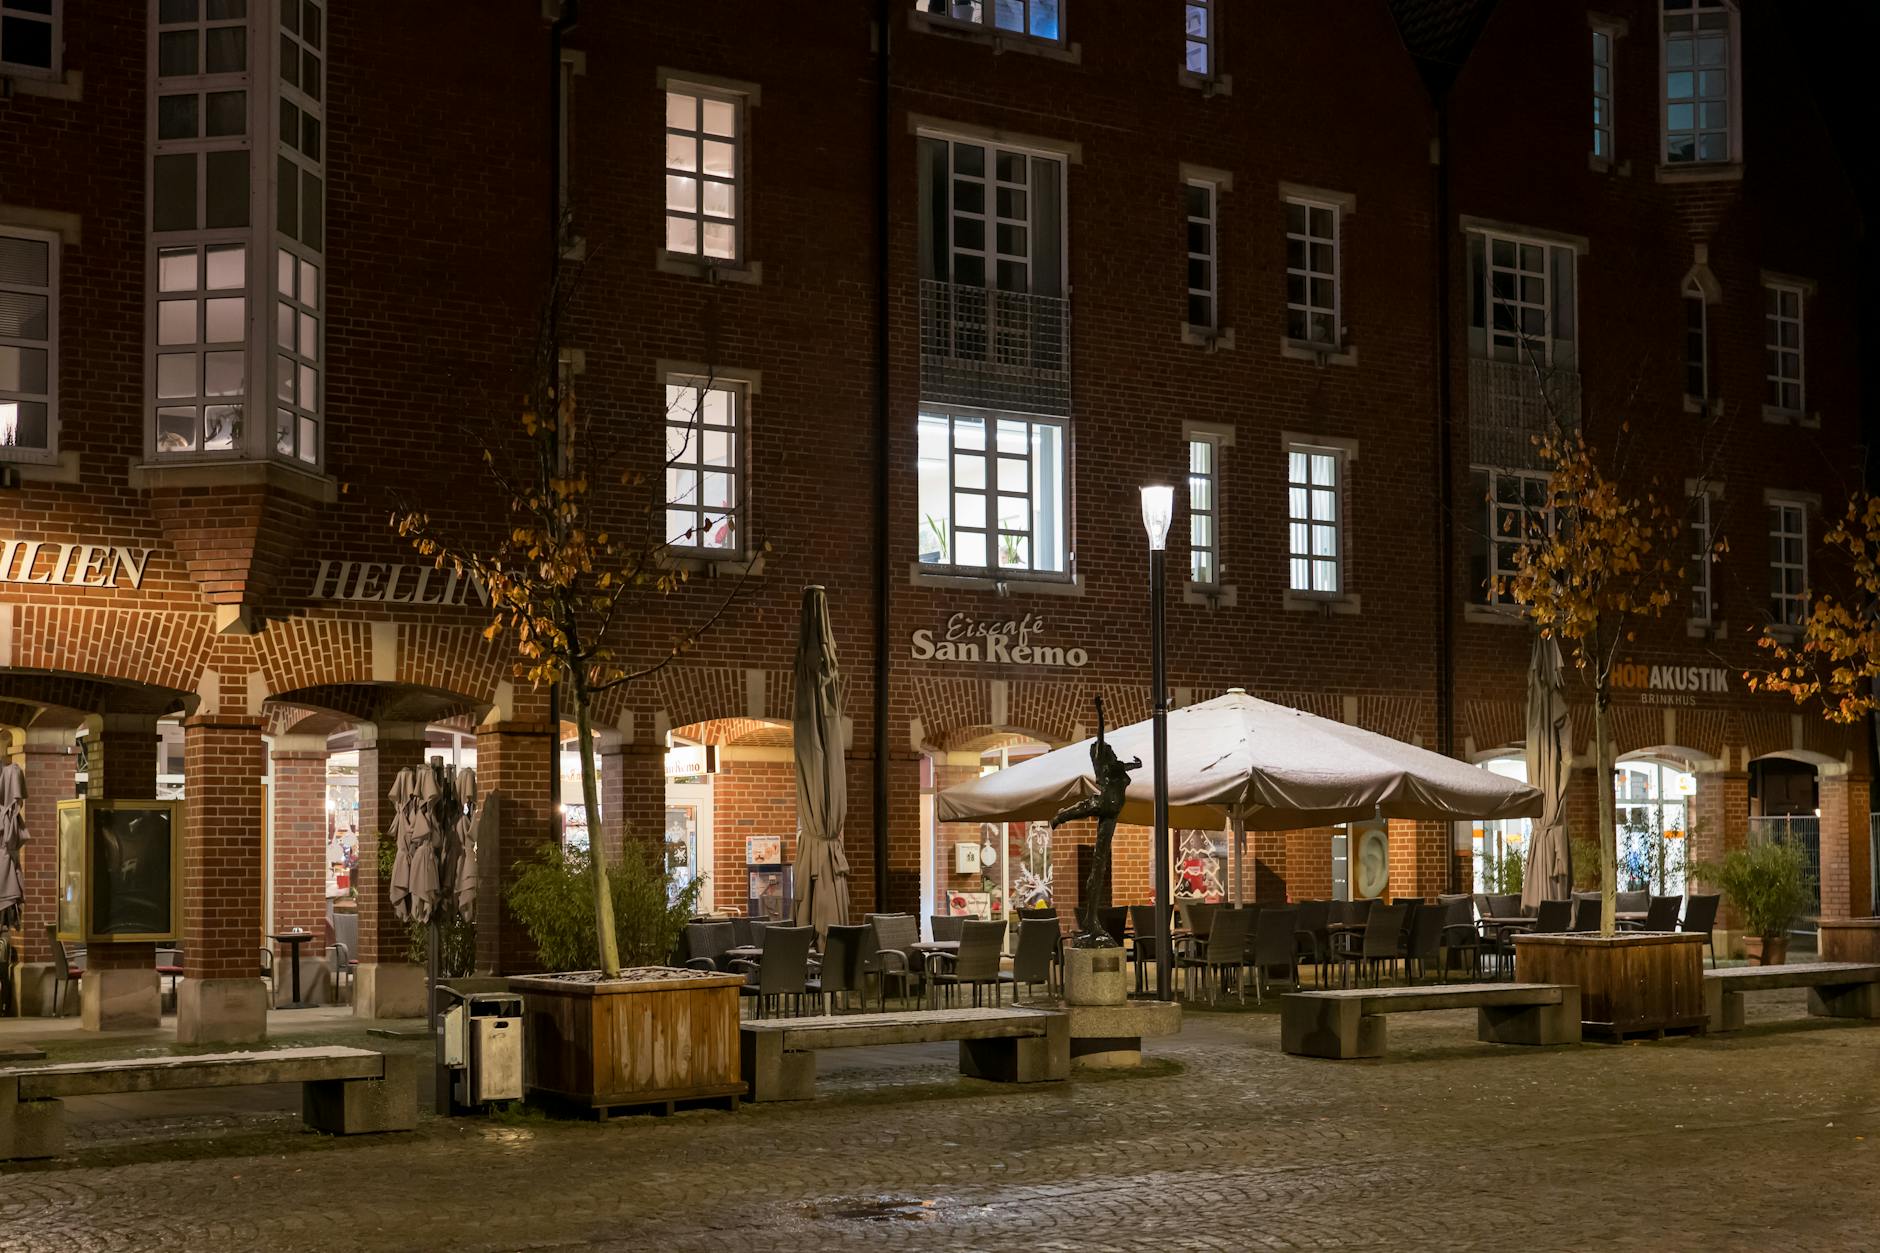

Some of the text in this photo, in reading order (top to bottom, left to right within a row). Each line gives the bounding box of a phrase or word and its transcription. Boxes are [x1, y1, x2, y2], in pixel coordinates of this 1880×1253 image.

[945, 612, 1045, 647] Eiscafé
[911, 629, 1088, 667] San Remo
[1641, 693, 1697, 706] BRINKHUS
